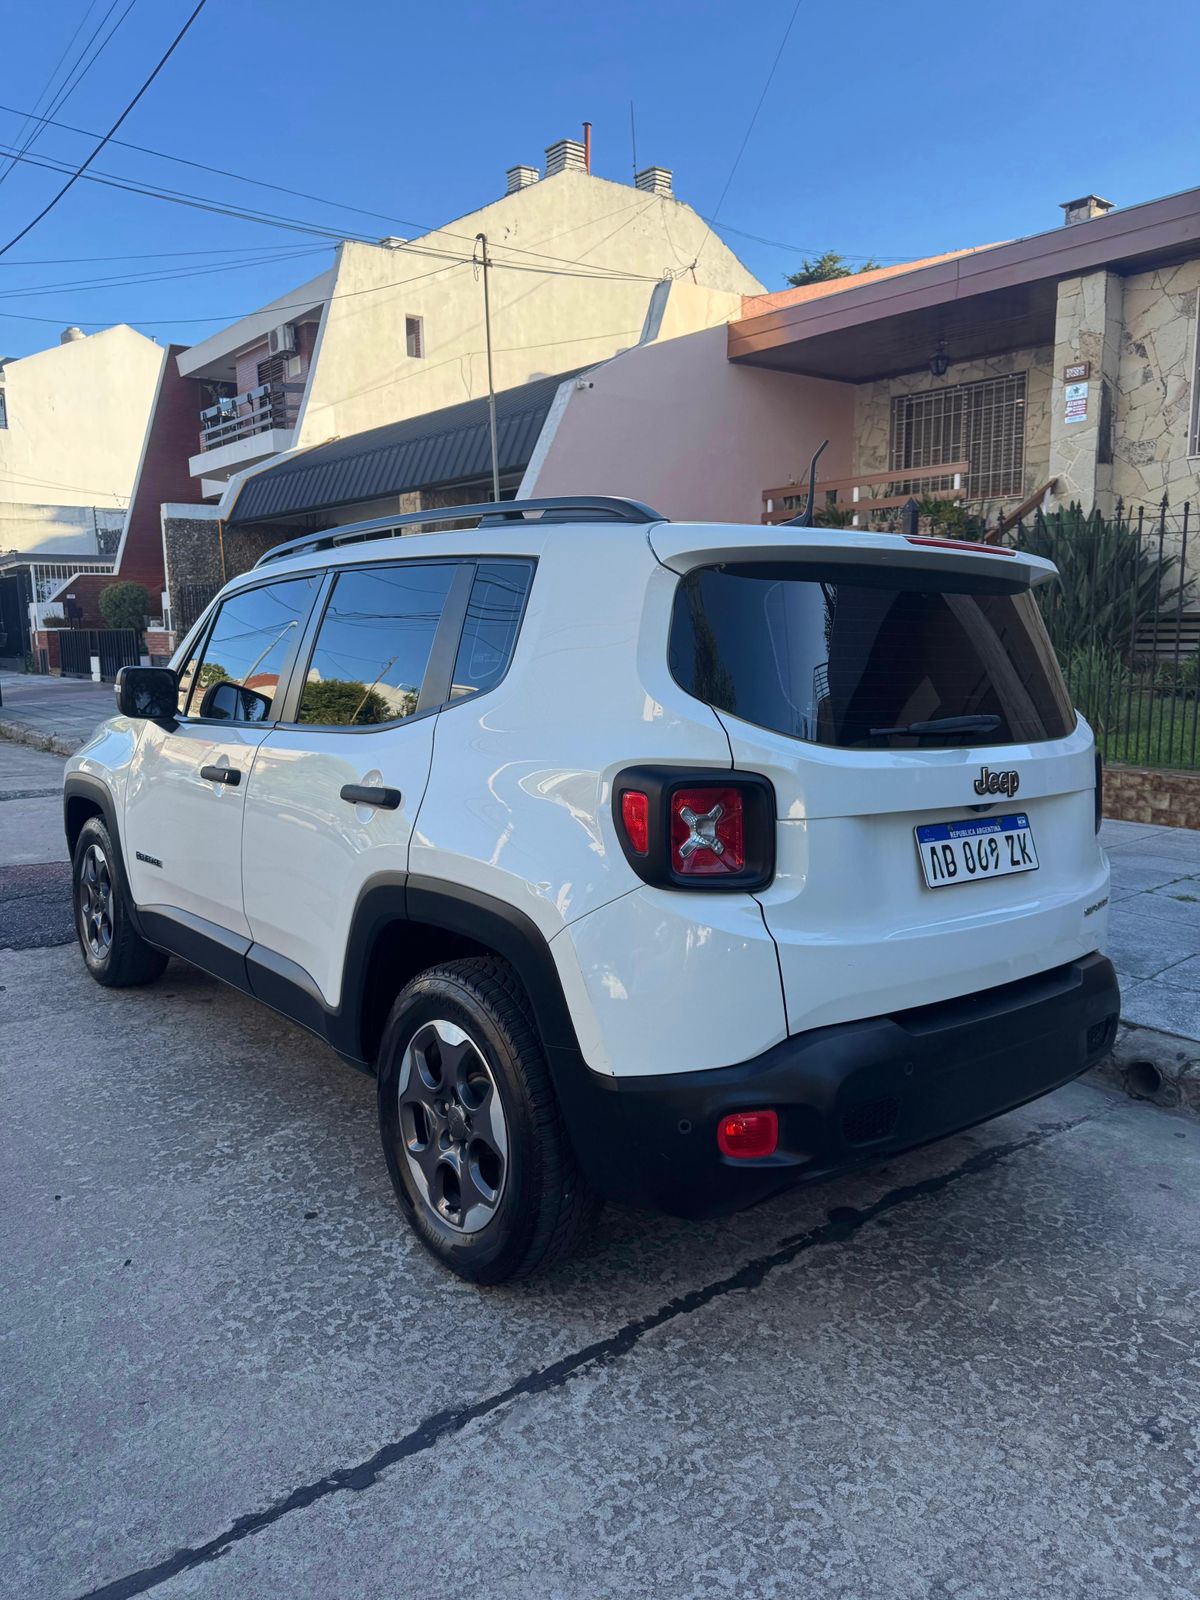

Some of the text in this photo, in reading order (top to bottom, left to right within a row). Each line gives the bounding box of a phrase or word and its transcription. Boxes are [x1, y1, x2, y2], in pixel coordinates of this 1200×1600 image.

[974, 767, 1019, 797] Jeep
[950, 825, 1002, 839] REPUBLICA ARGENTINA
[930, 844, 957, 880] AB
[1005, 832, 1033, 867] ZK
